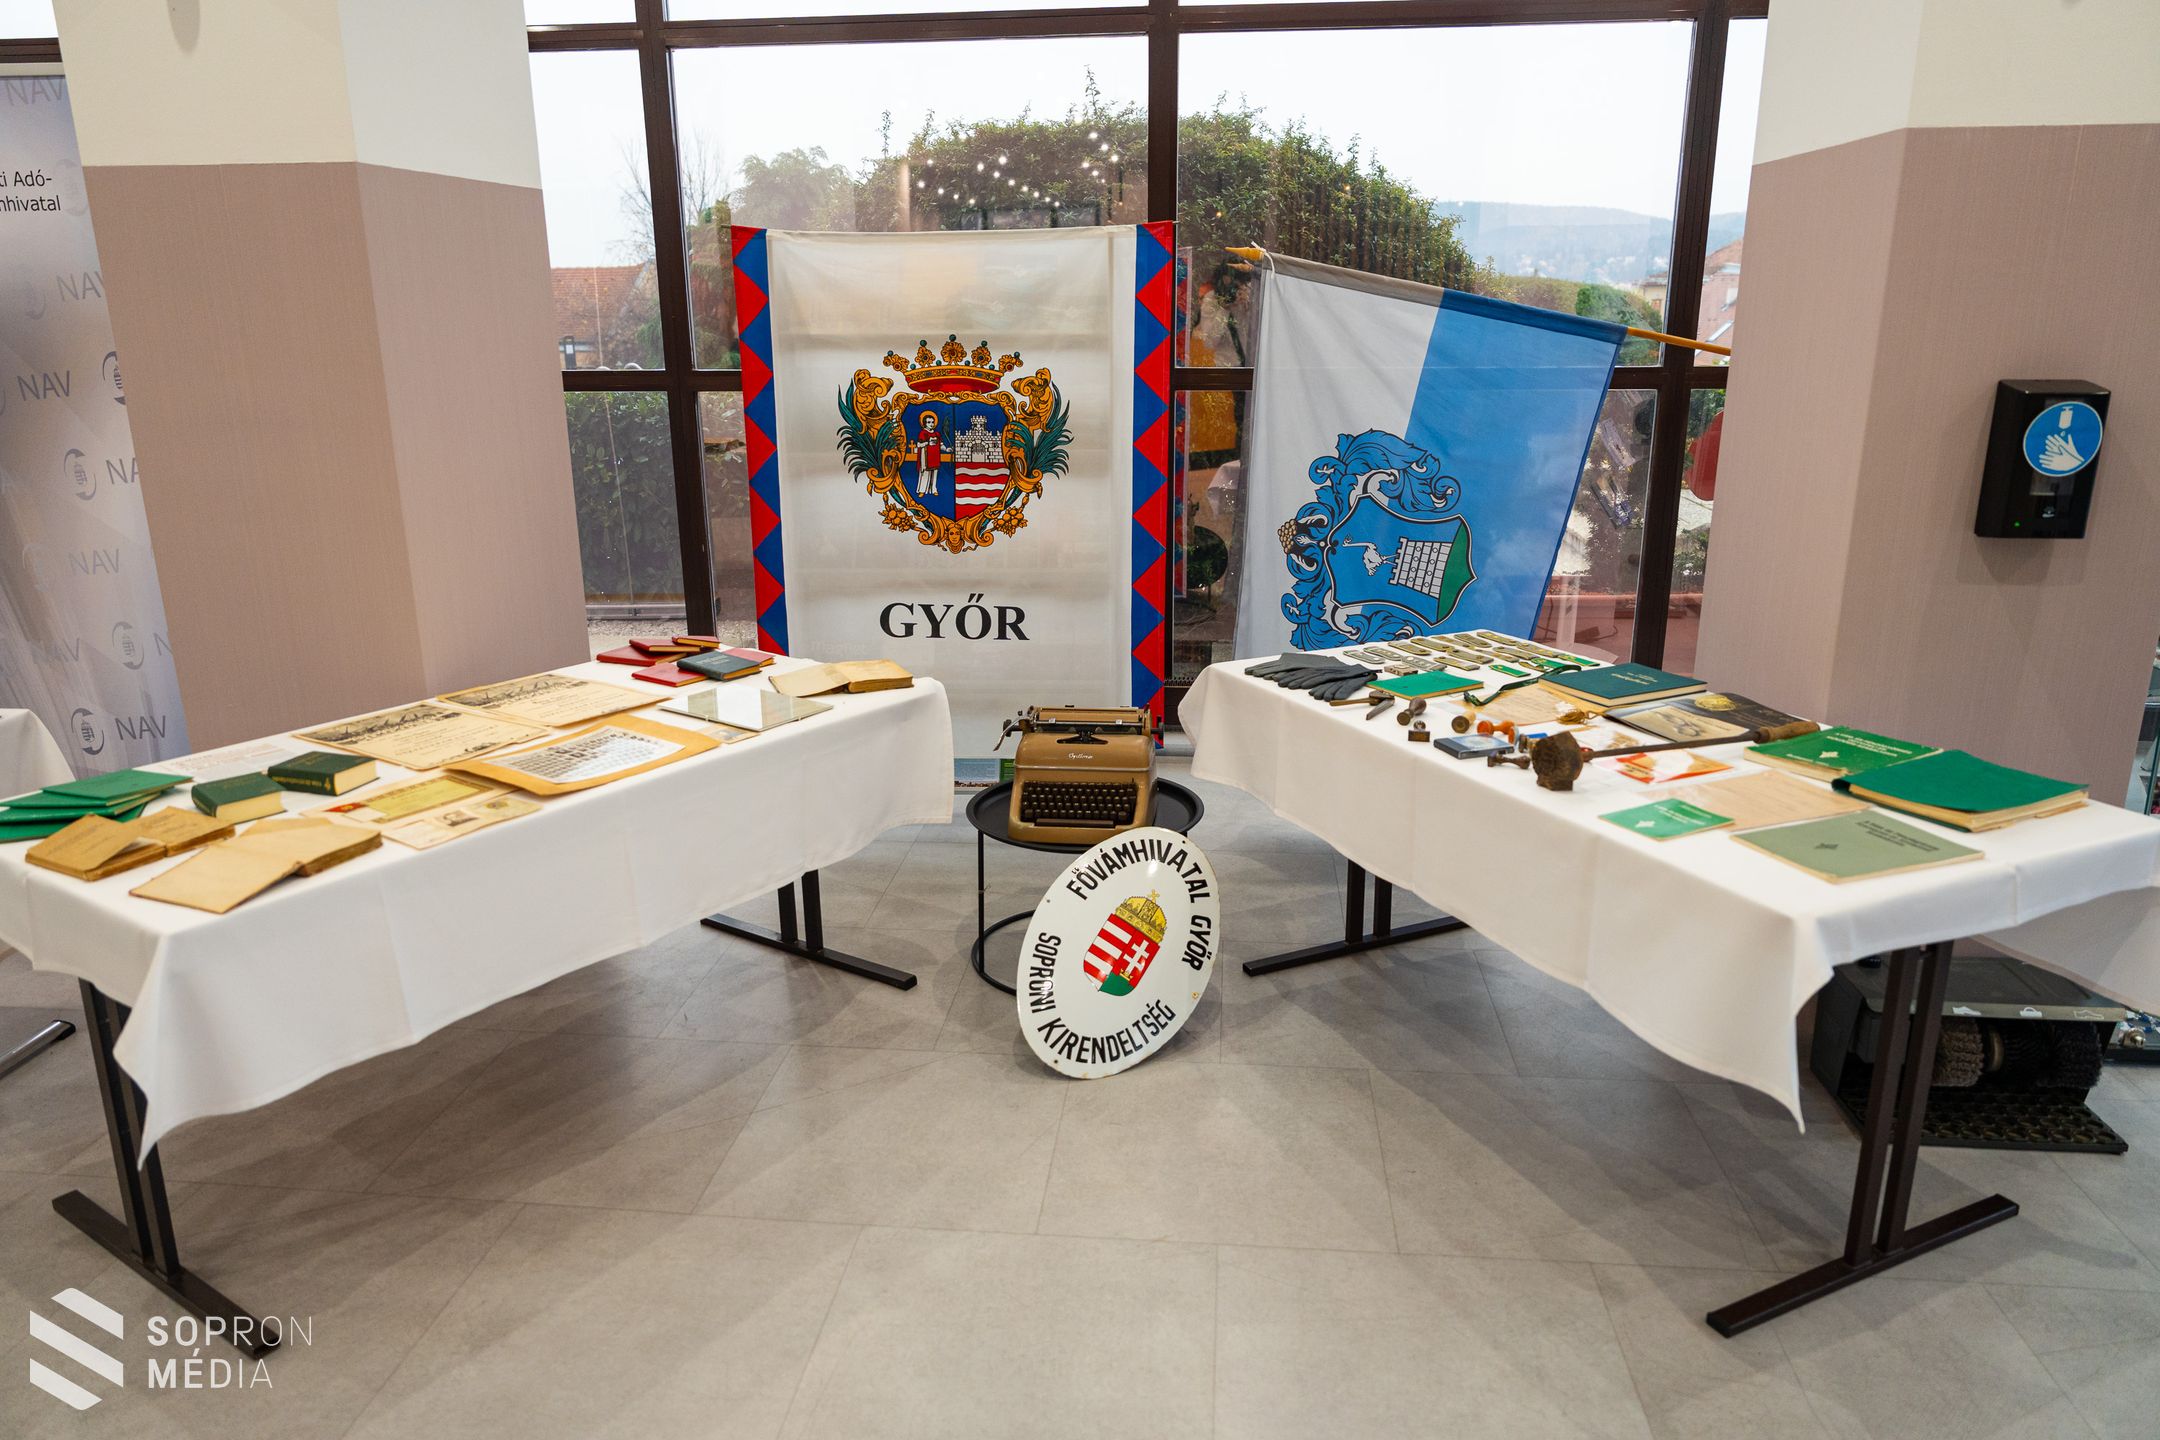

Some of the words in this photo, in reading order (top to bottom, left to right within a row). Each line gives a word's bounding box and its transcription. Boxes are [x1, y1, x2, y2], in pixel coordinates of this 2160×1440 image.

[5, 78, 63, 106] NAV
[13, 169, 53, 187] Adó-
[17, 370, 71, 401] NAV
[69, 549, 120, 577] NAV
[879, 593, 1031, 641] GYŐR
[114, 715, 166, 741] NAV
[1028, 932, 1062, 1014] SOPRONI
[1037, 999, 1176, 1065] KIRENDELTSÉG
